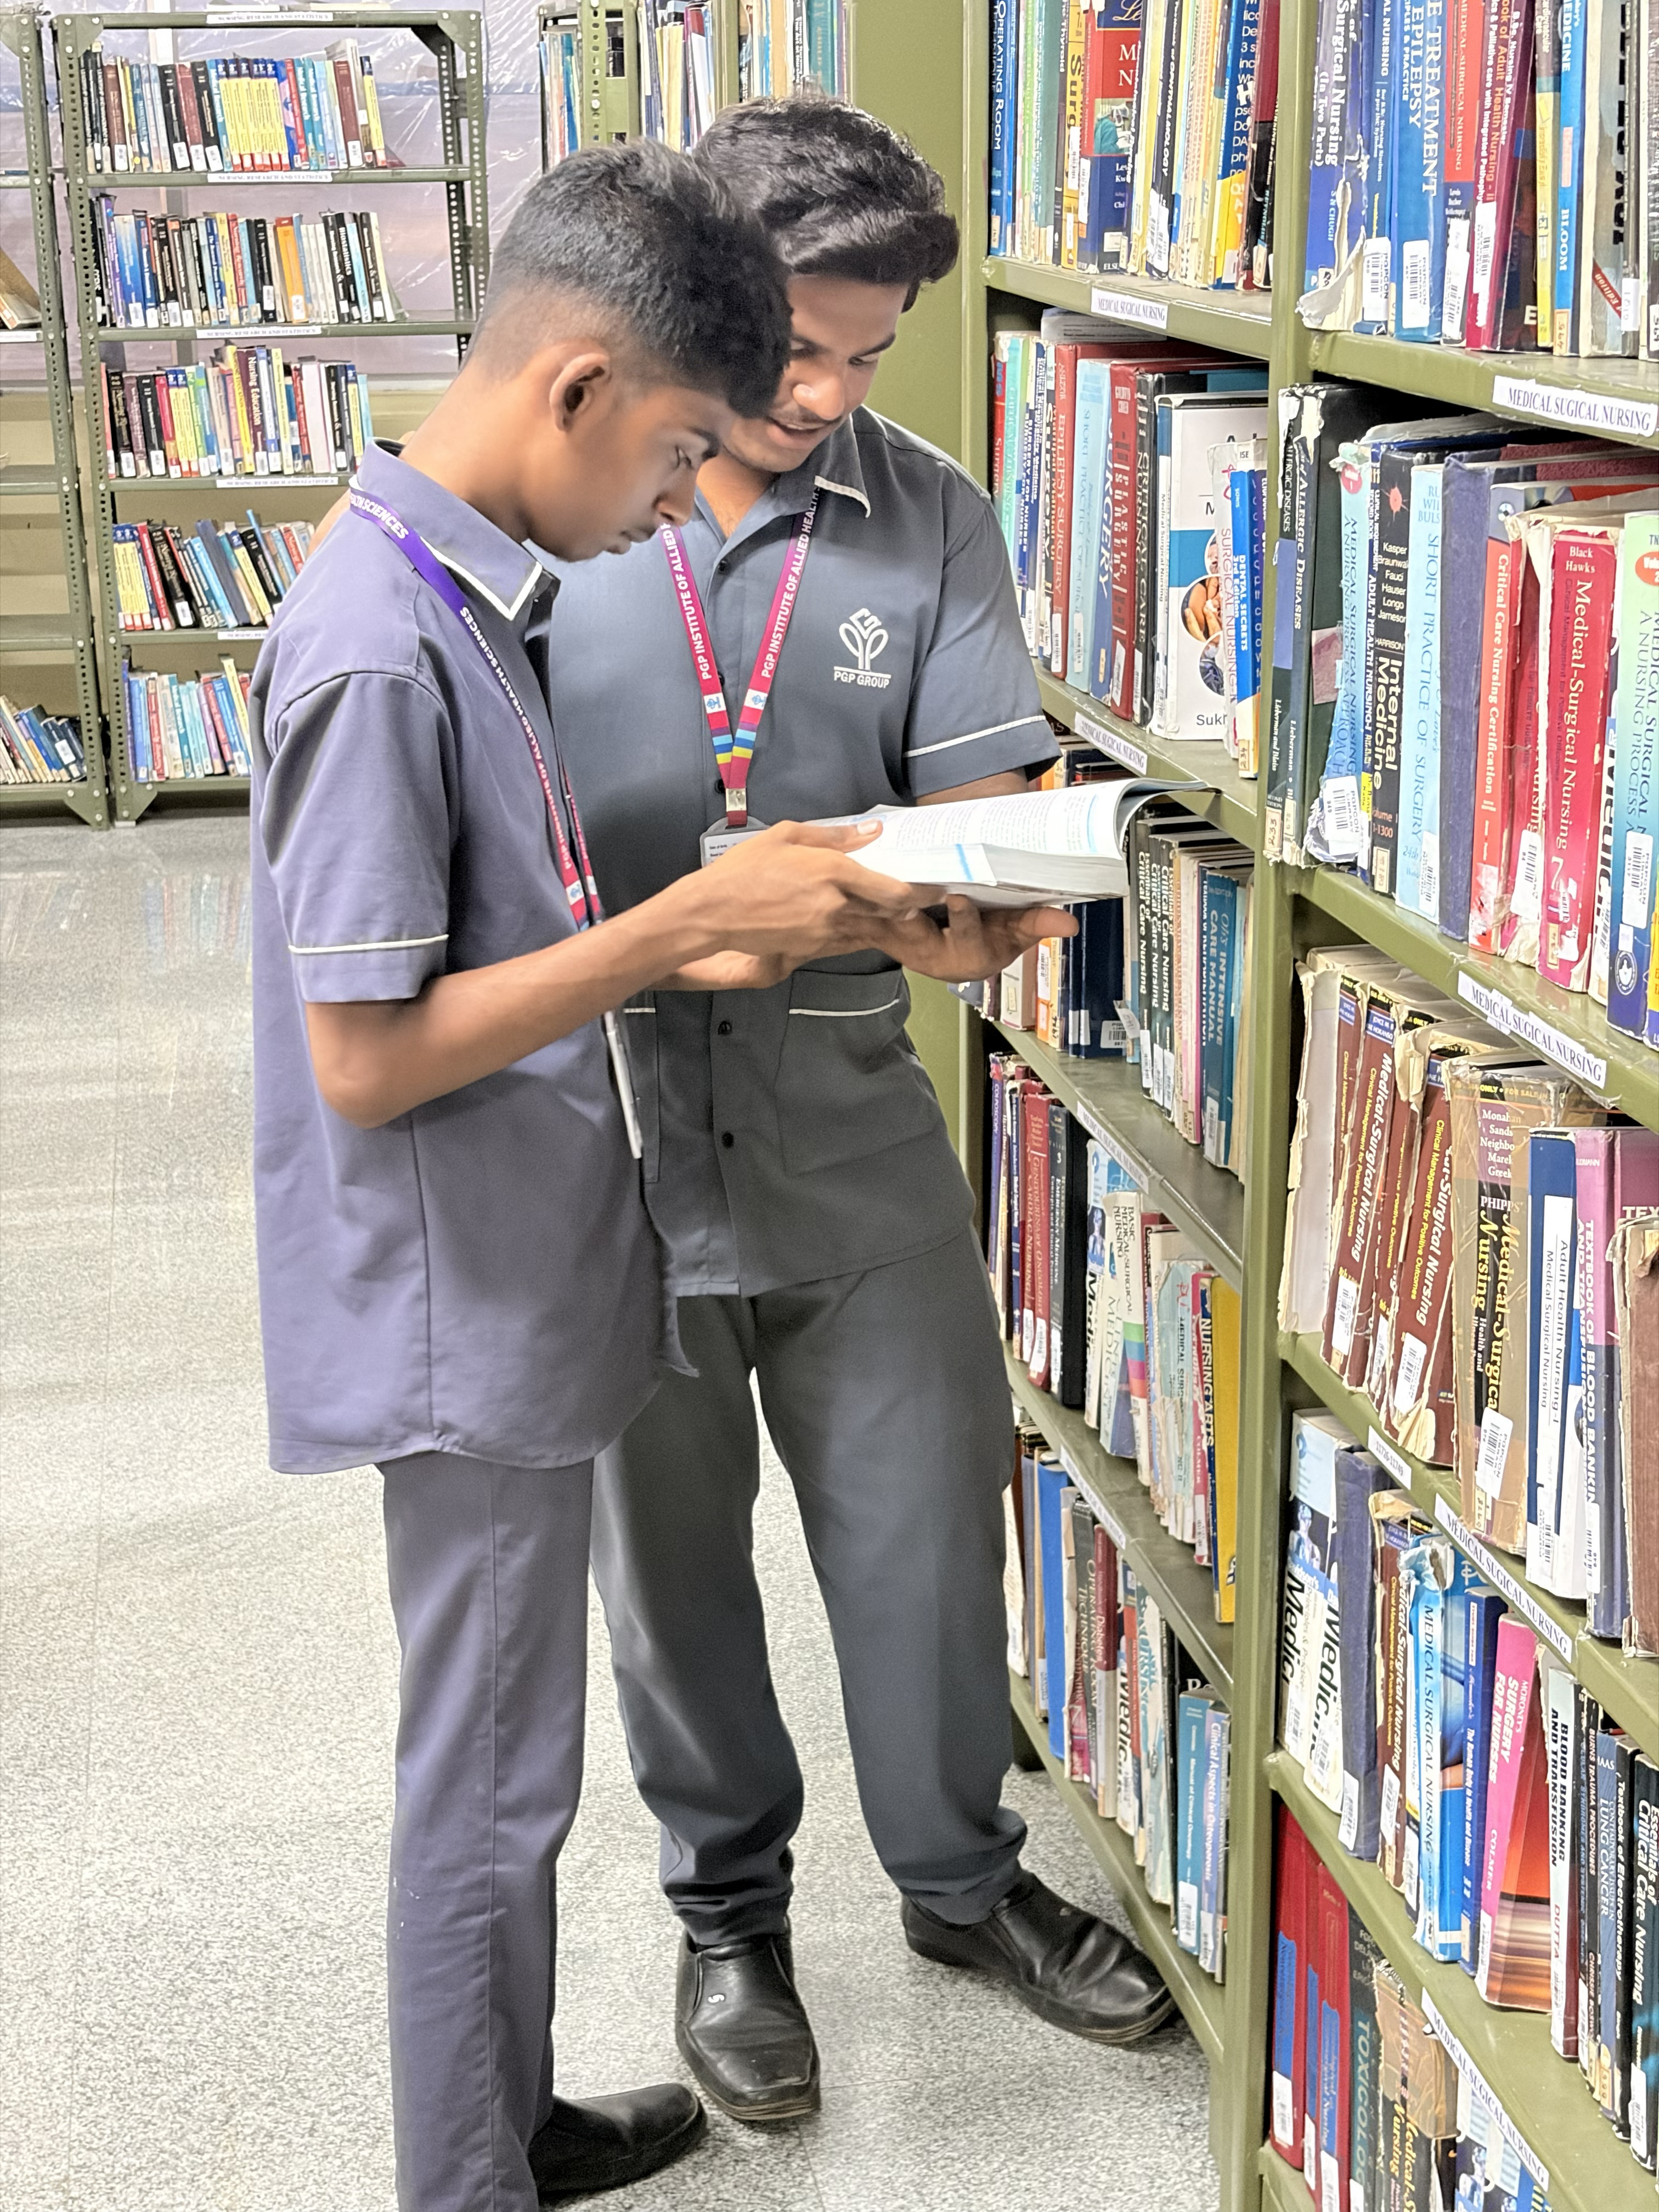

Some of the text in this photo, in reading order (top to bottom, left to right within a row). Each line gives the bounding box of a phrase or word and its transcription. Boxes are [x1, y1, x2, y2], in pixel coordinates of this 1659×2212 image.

[994, 0, 1006, 150] OPERATING ROOM
[1325, 0, 1350, 166] Surgical Nursing
[1381, 18, 1391, 76] NURSING
[1409, 7, 1423, 128] EPILEPSY
[1314, 127, 1326, 166] Parts)
[1423, 26, 1442, 196] TREATMENT
[1486, 46, 1508, 180] Adult Health Nursing
[1559, 209, 1570, 270] BLOOM
[248, 357, 262, 426] Nursing Education
[1508, 388, 1650, 431] MEDICAL SUGICAL NURSING
[994, 437, 1003, 498] Surgery
[1055, 414, 1066, 594] EPILEPSY SURGERY
[363, 500, 409, 540] SCIENCES
[1138, 453, 1150, 642] CRITICAL CARE
[1295, 478, 1308, 629] ALLERGIC DISEASES
[1383, 542, 1407, 554] Kasper
[1566, 560, 1595, 573] Hawks
[1569, 546, 1593, 559] Black
[664, 530, 712, 680] PGP INSTITUTE OF ALLIED
[761, 654, 777, 678] PGP
[770, 591, 794, 653] INSTITUTE
[786, 575, 799, 591] OF
[795, 533, 810, 575] ALLIED
[1221, 528, 1234, 612] SURGICAL
[1233, 578, 1241, 618] Edition
[1238, 555, 1249, 651] DENTAL SECRETS
[1368, 574, 1377, 616] ADULT
[1382, 583, 1406, 596] Hauser
[1383, 597, 1404, 610] Longo
[1385, 571, 1403, 582] Fauci
[460, 607, 499, 664] SCIENCES
[834, 672, 890, 688] PGP GROUP
[1485, 554, 1509, 794] Critical Care Nursing Certification
[495, 664, 524, 717] HEALTH
[522, 716, 541, 758] ALLIED
[1374, 657, 1390, 789] Medicine
[1386, 659, 1402, 770] Internal
[1411, 534, 1440, 844] SHORT PRACTICE OF SURGERY
[1556, 580, 1592, 850] Medical-Surgical Nursing
[1627, 631, 1652, 816] NURSING PROCESS
[1639, 715, 1656, 814] SURGICAL
[1138, 851, 1147, 994] Critical Care Nursing
[1151, 918, 1160, 1008] Care Nursing
[1161, 866, 1170, 1012] Critical Care Nursing
[1207, 910, 1219, 1042] CARE MANUAL
[1215, 952, 1228, 1046] INTENSIVE
[1471, 986, 1601, 1081] MEDICAL SUGICAL NURSING
[1350, 1053, 1392, 1262] Medical-Surgical Nursing
[1489, 1125, 1513, 1137] Sands
[1114, 1206, 1125, 1257] NURSING
[1127, 1206, 1136, 1241] BASIC
[1410, 1120, 1444, 1299] Clinical Management Positive Outcomes
[1416, 1256, 1440, 1326] Nursing
[1473, 1211, 1499, 1311] Nursing
[1556, 1240, 1569, 1341] Adult Health
[1540, 1250, 1554, 1408] Medical Surgical Nursing
[1585, 1221, 1596, 1421] TEXTBOOK OF BLOOD
[1201, 1318, 1215, 1448] NURSING ARTS
[1447, 1514, 1568, 1655] MEDICAL SUGICAL NURSING
[1096, 1616, 1105, 1661] Diabetes
[1210, 1723, 1221, 1759] Clinical
[1390, 1708, 1403, 1771] Nursing
[1423, 1605, 1434, 1854] MEDICAL SURGICAL NURSING
[1488, 1671, 1506, 1782] FOR NURSES
[1501, 1677, 1519, 1763] SURGERY
[1208, 1762, 1219, 1800] Aspects
[1550, 1707, 1560, 1867] AND TRANSFUSION
[1559, 1723, 1569, 1862] BLOOD BANKING
[1616, 1781, 1626, 1848] Textbook
[1600, 1798, 1610, 1915] LUNG CANCER
[1632, 1800, 1650, 2004] Critical Care Nursing
[1434, 2012, 1545, 2183] MEDICAL SUGICAL NURSING
